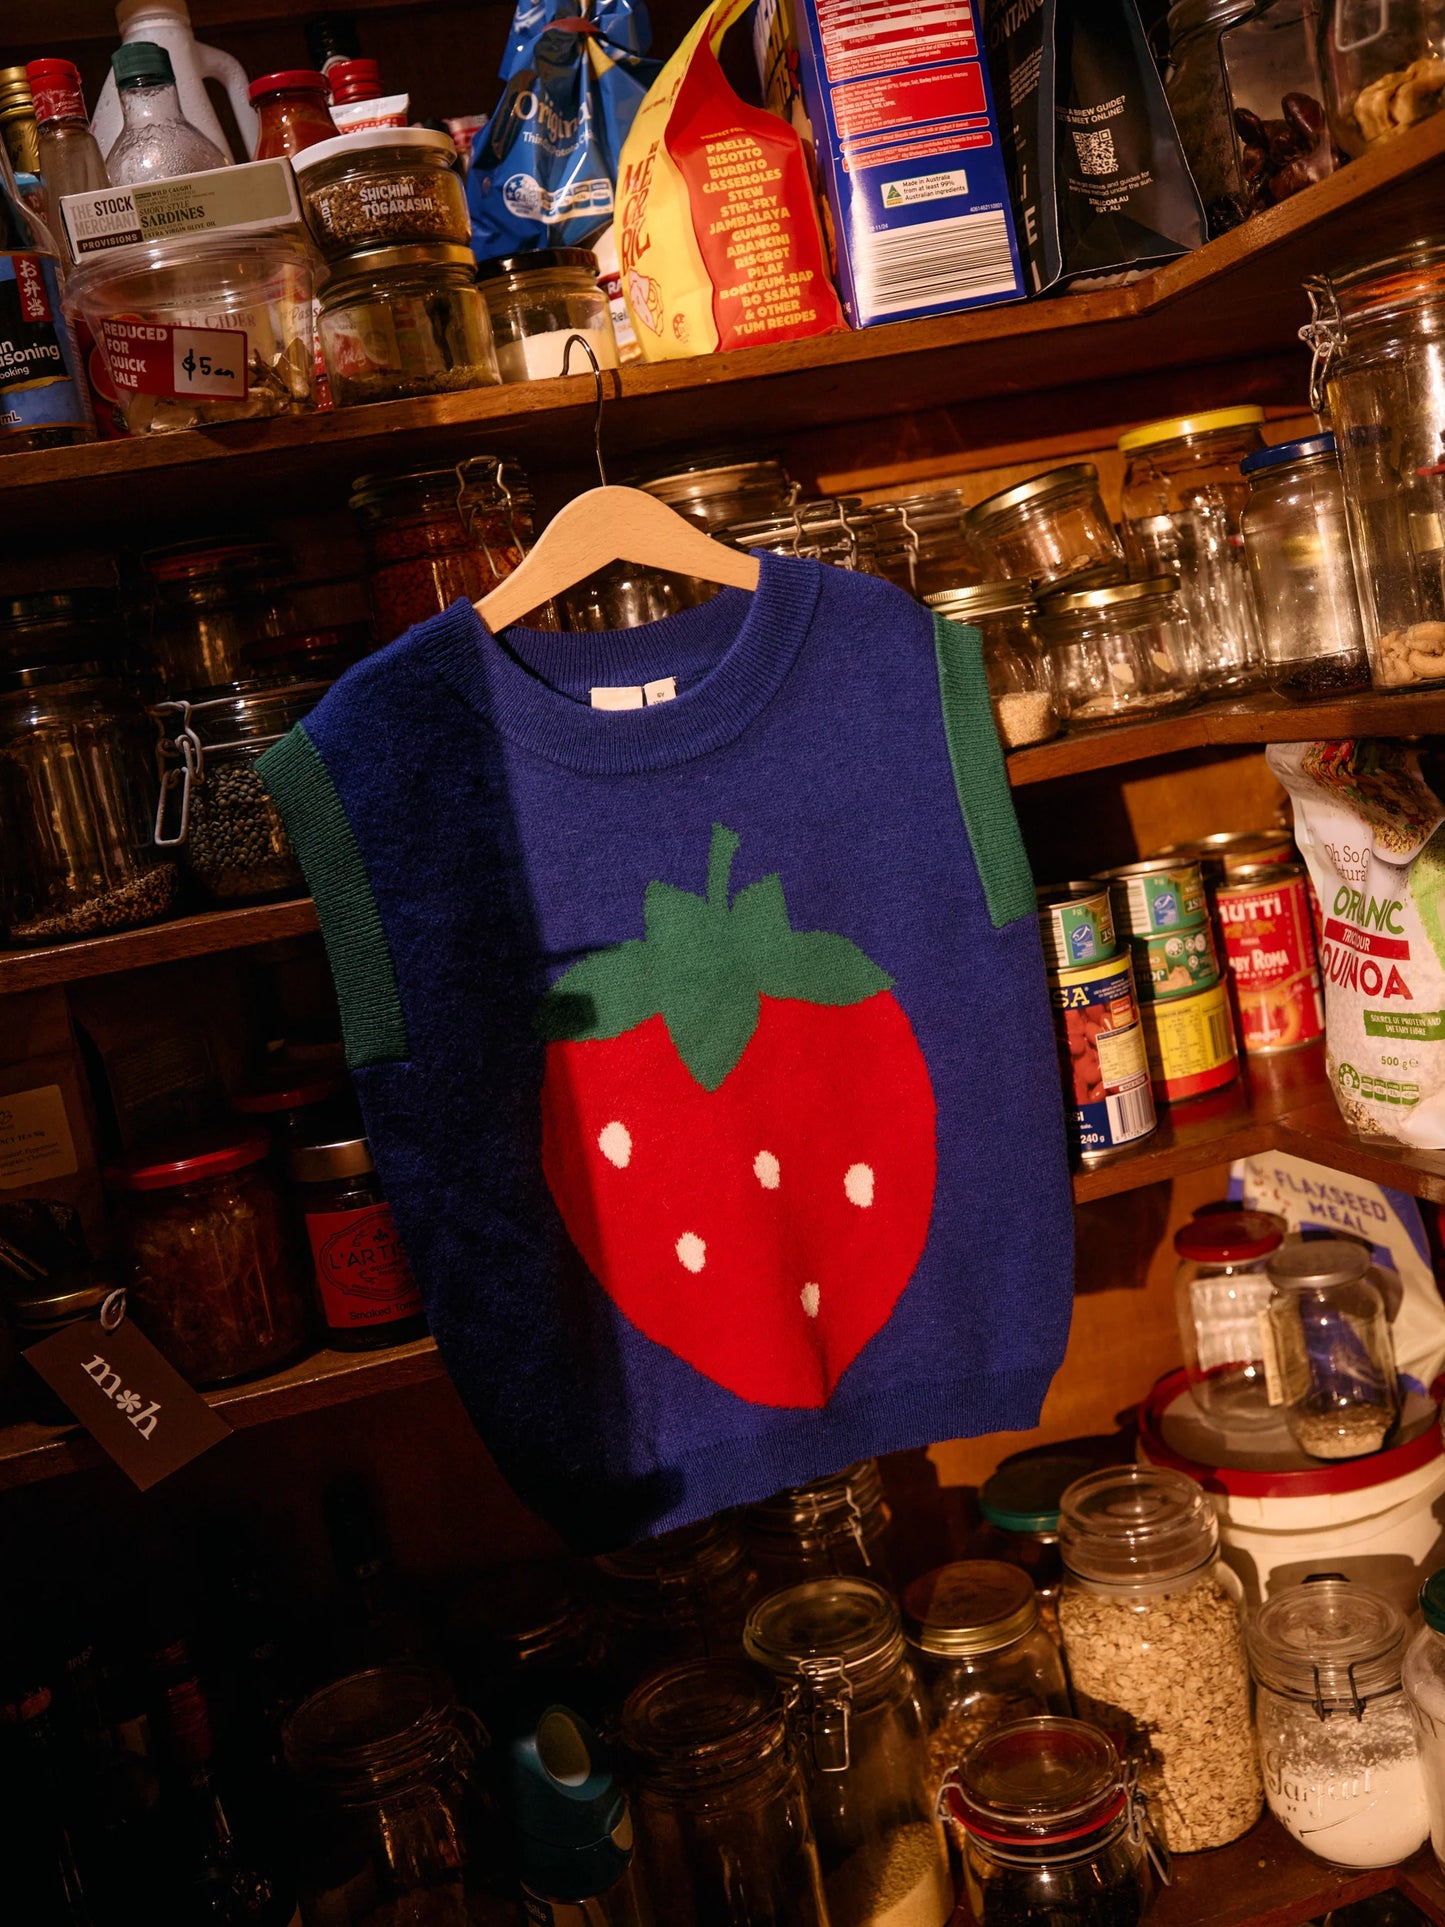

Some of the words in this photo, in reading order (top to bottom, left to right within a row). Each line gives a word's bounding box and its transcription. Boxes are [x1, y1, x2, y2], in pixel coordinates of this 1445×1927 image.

[1096, 95, 1126, 113] GUIDE?
[1091, 105, 1125, 123] ONLINE!
[705, 137, 757, 154] PAELLA
[706, 147, 763, 167] RISOTTO
[709, 158, 768, 180] BURRITO
[702, 168, 783, 194] CASSEROLES
[902, 178, 919, 189] Made
[926, 174, 951, 185] Australia
[904, 186, 918, 194] from
[926, 182, 940, 191] least
[940, 180, 955, 189] 99%
[1120, 176, 1141, 187] guides
[151, 187, 168, 198] WILD
[168, 184, 193, 195] CAUGHT
[359, 183, 415, 203] SHICHIMI
[728, 185, 764, 203] STEW
[905, 191, 935, 201] Australian
[934, 185, 966, 198] ingredients
[70, 202, 95, 222] THE
[94, 194, 134, 218] STOCK
[720, 195, 778, 218] STIR-FRY
[74, 212, 138, 238] MERCHANT
[140, 206, 206, 229] SARDINES
[710, 207, 791, 236] JAMBALAYA
[82, 232, 139, 251] PROVISIONS
[164, 226, 186, 238] VIRGIN
[732, 222, 781, 242] GUMBO
[726, 234, 791, 259] ARANCINI
[747, 261, 784, 279] PILAF
[20, 258, 46, 319] お弁当
[720, 270, 814, 300] BOKKEUM-BAP
[742, 294, 762, 308] BO
[745, 308, 756, 321] &
[756, 300, 801, 318] OTHER
[102, 321, 168, 342] REDUCED
[733, 320, 767, 336] YUM
[766, 309, 817, 330] RECIPES
[107, 338, 130, 355] FOR
[110, 352, 147, 374] QUICK
[113, 370, 139, 389] SALE
[1, 410, 22, 425] mL
[1343, 845, 1360, 864] So
[1252, 948, 1290, 972] ROMA
[1322, 942, 1414, 1001] QUINOA
[1370, 1014, 1392, 1025] SOURCE
[1394, 1016, 1401, 1025] OF
[1402, 1018, 1426, 1027] PROTEIN
[1426, 1017, 1442, 1027] AND
[1386, 1024, 1409, 1034] DIETARY
[1381, 1056, 1400, 1067] 500
[1402, 1061, 1408, 1071] g
[1080, 1132, 1099, 1145] 240
[1274, 1168, 1388, 1223] FLAXSEED
[1308, 1200, 1370, 1236] MEAL
[350, 1303, 393, 1322] Smoked
